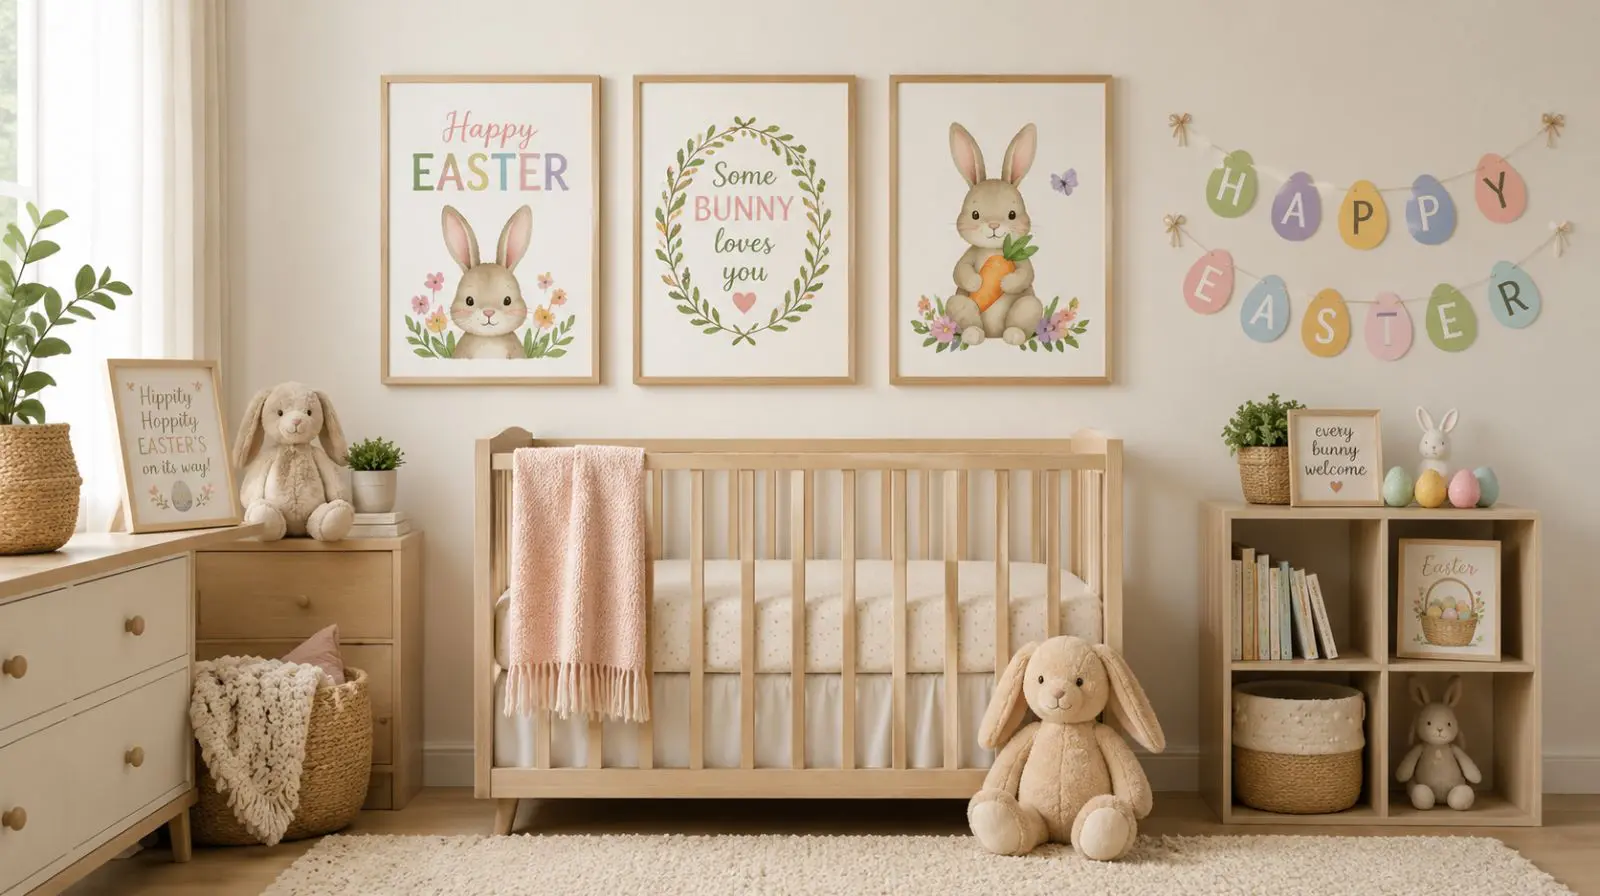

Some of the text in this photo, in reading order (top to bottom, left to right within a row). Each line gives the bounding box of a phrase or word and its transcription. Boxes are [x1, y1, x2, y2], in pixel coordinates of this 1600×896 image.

[442, 110, 538, 149] Happy
[412, 152, 569, 191] EASTER
[712, 161, 777, 188] Some
[694, 195, 794, 222] BUNNY
[1215, 167, 1507, 236] HAPPY
[713, 227, 776, 255] loves
[722, 266, 768, 291] you
[1194, 265, 1529, 347] EASTER
[140, 386, 193, 411] Hippity
[141, 411, 199, 434] Hoppity
[1315, 426, 1354, 443] every
[138, 435, 208, 456] EASTER'S
[1312, 440, 1360, 462] bunny
[142, 458, 211, 478] on its way!
[1305, 459, 1367, 476] welcome
[1422, 555, 1480, 577] Easter
